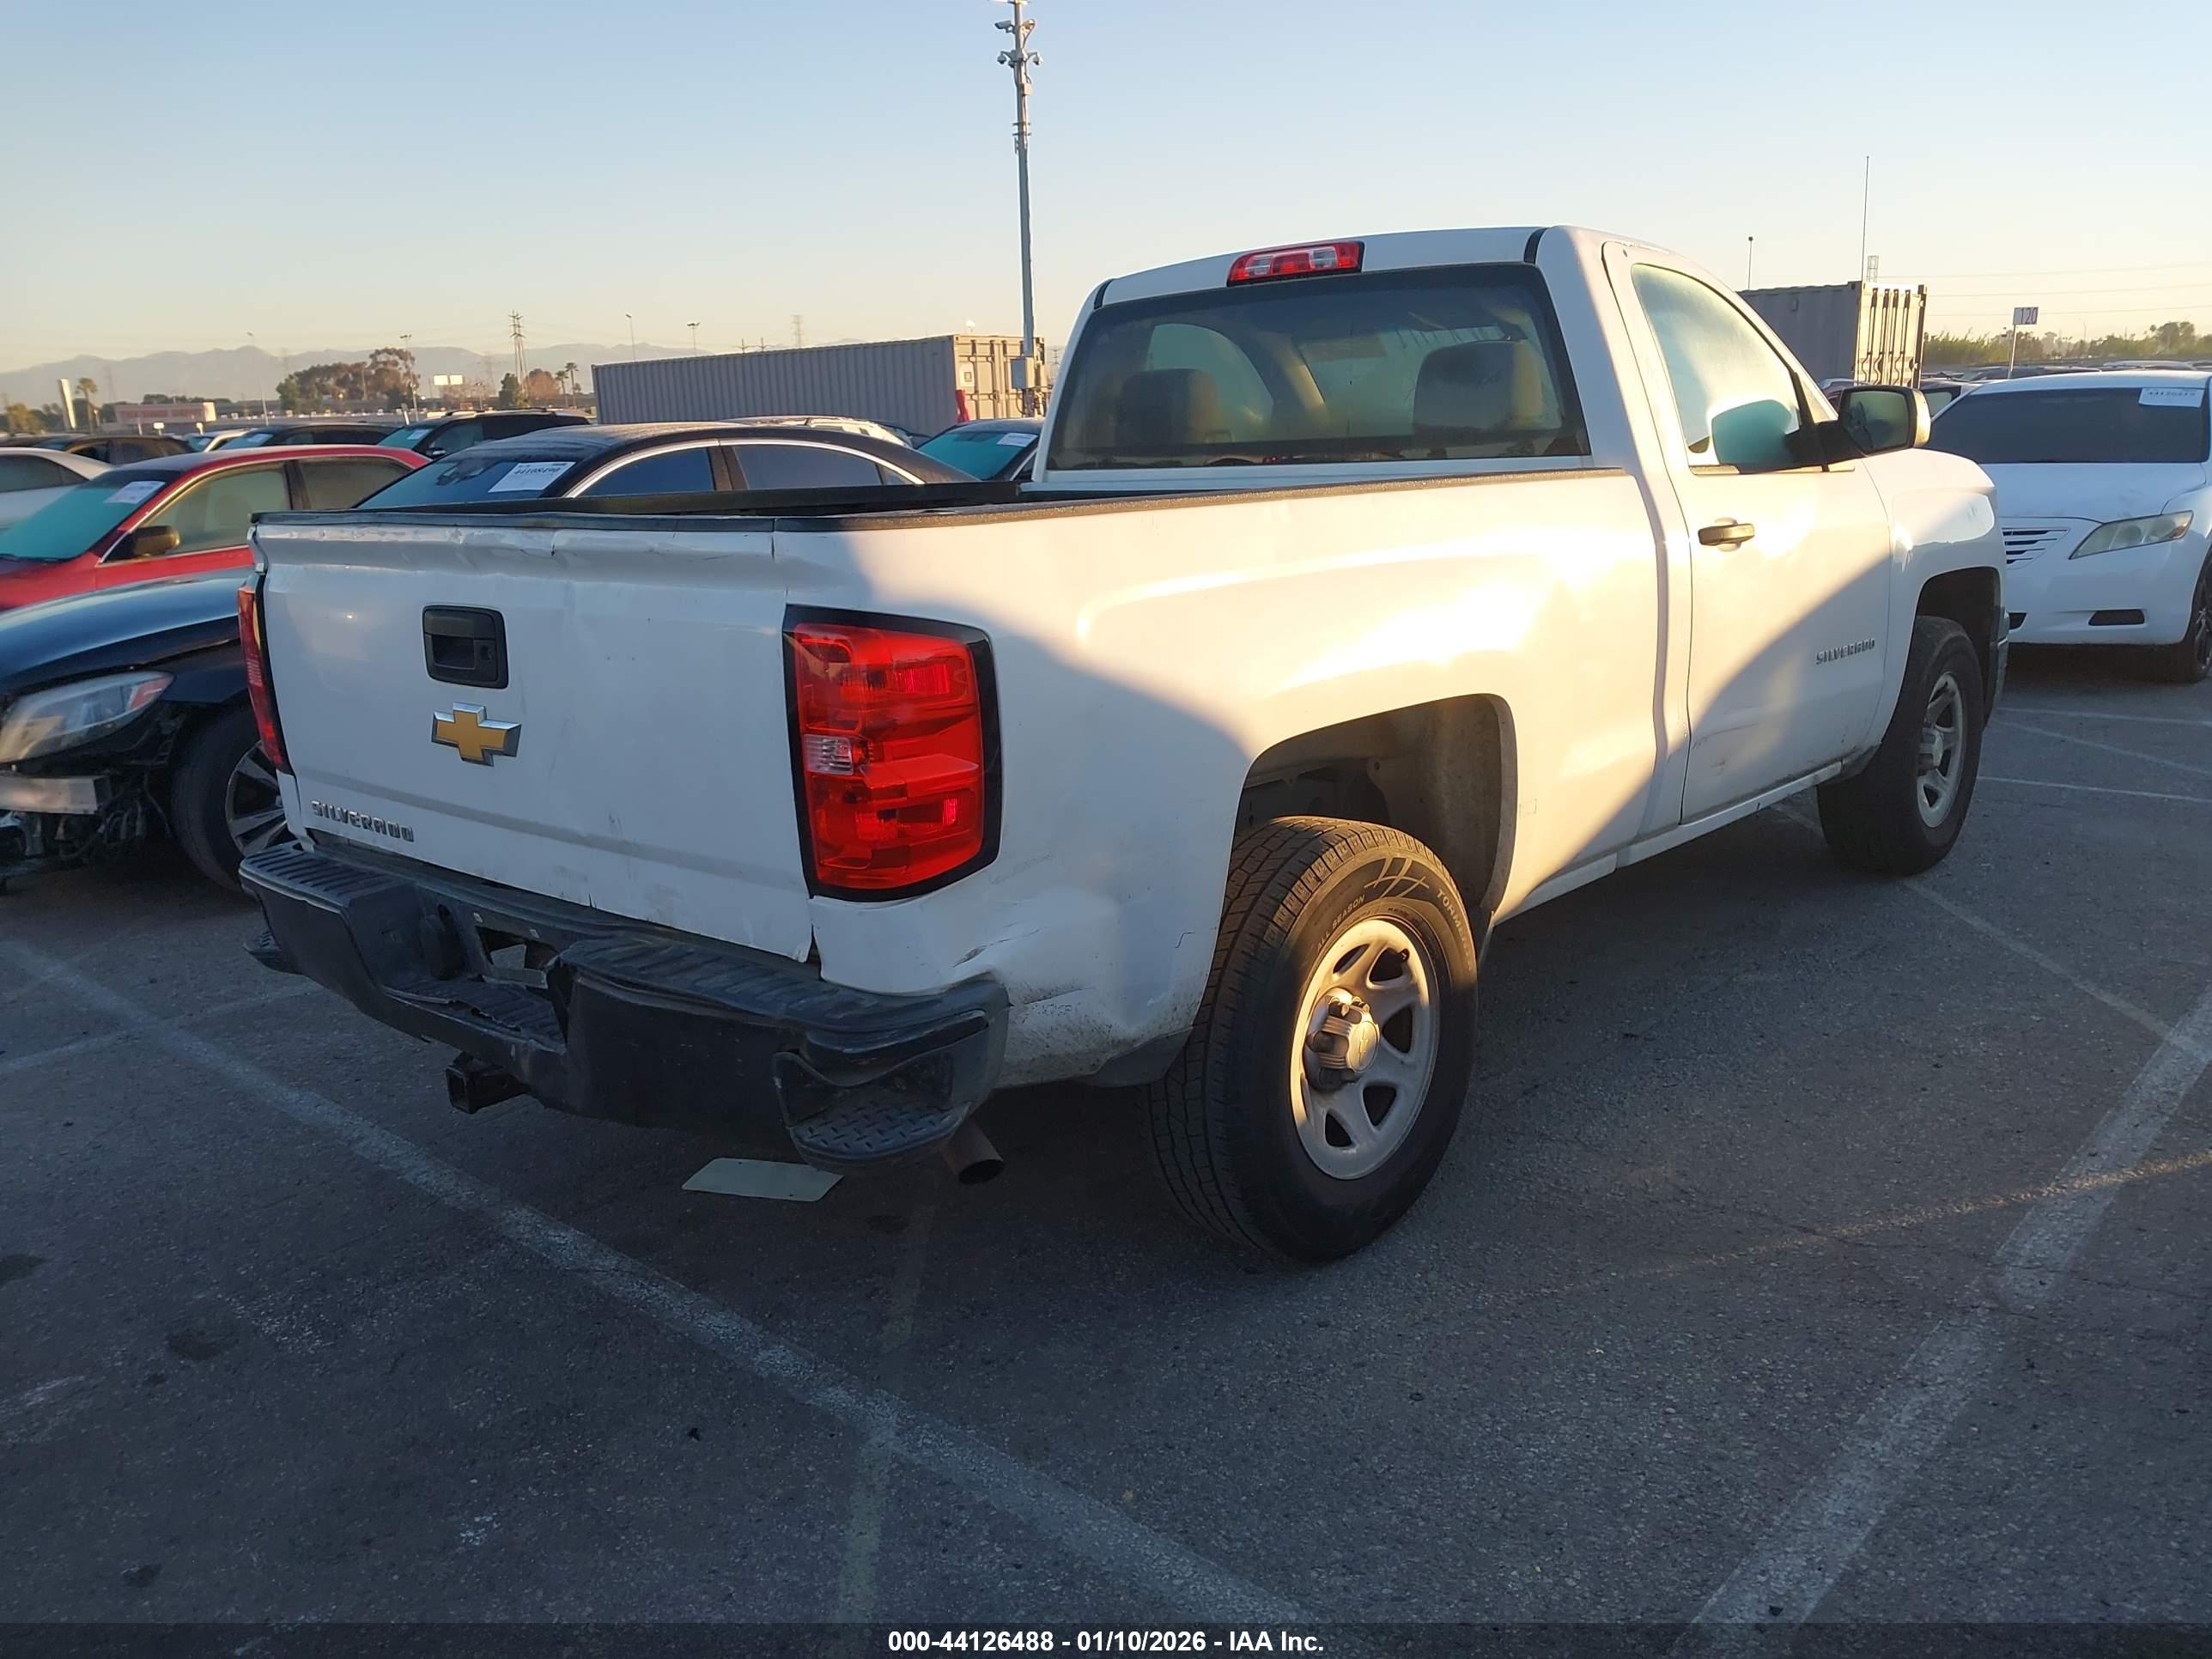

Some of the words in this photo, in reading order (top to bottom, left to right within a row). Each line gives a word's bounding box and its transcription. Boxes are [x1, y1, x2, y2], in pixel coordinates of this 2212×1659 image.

[1815, 637, 1875, 665] SILVERADO
[311, 799, 415, 843] SILVERADO
[1331, 894, 1366, 930] SEASON
